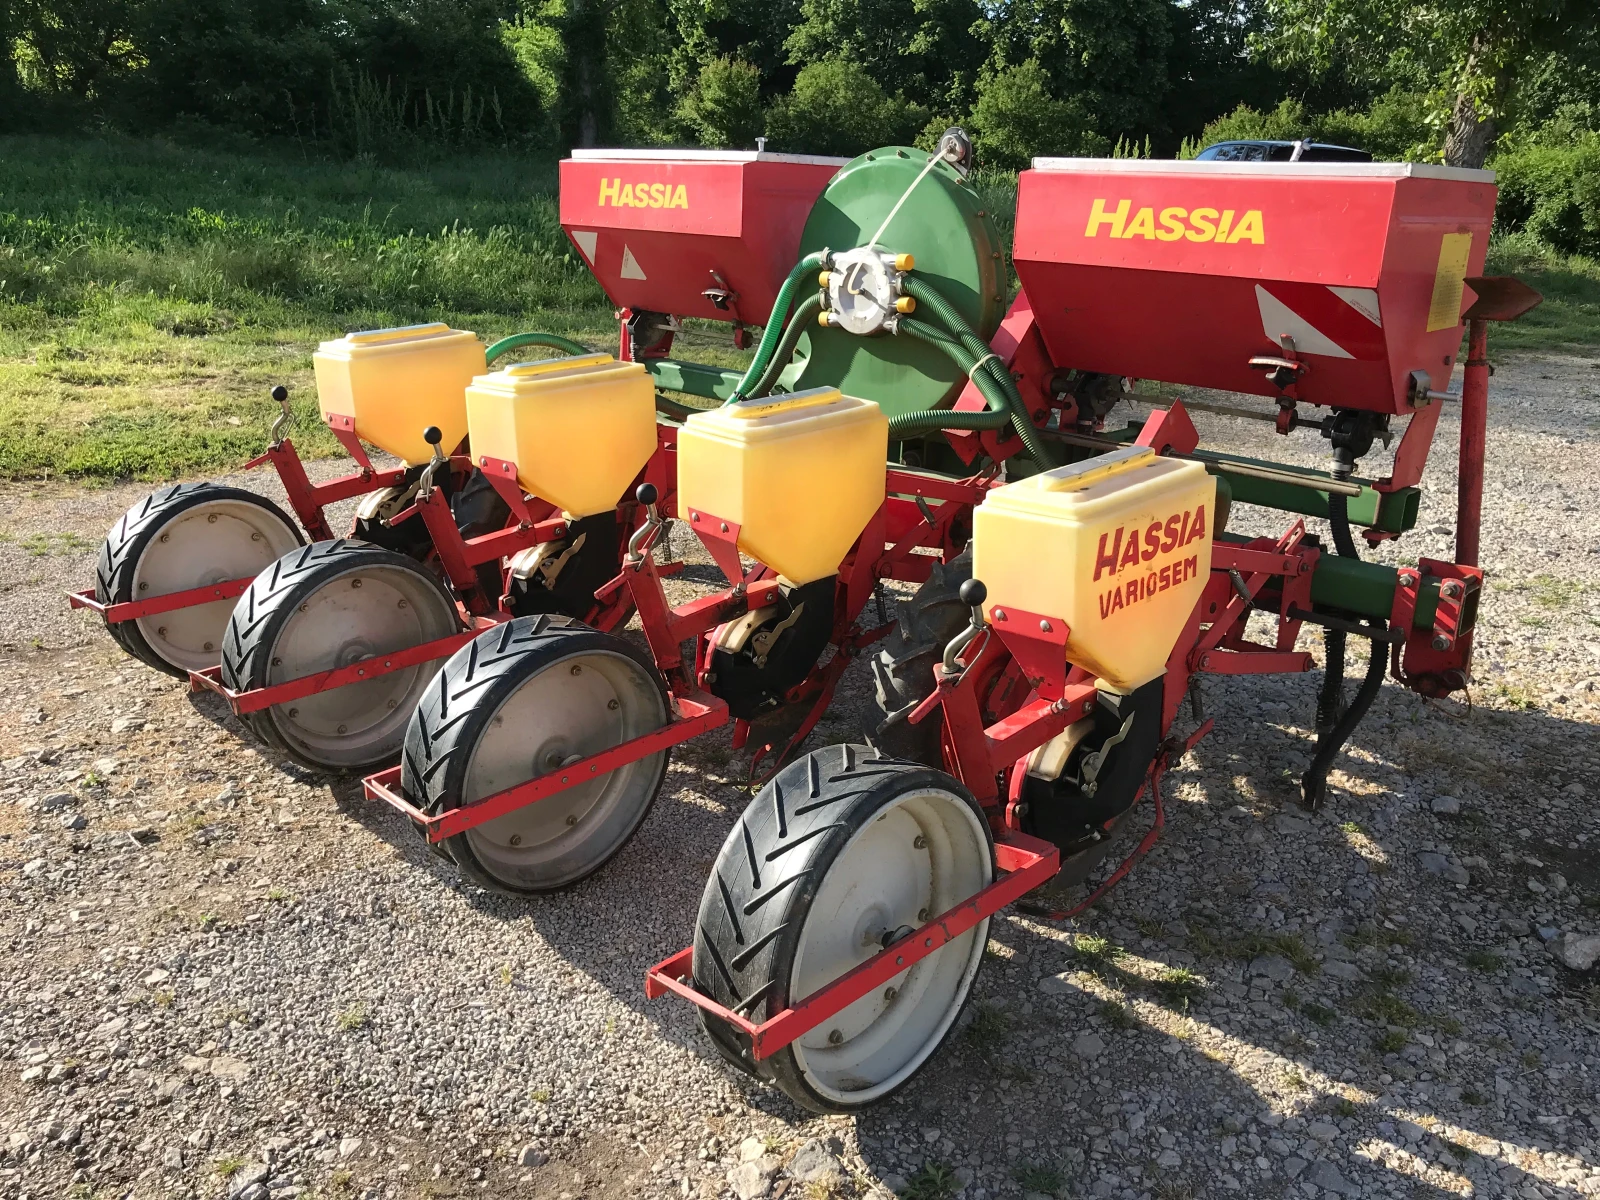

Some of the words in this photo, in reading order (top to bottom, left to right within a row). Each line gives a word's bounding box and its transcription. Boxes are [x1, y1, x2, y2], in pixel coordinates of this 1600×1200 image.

[598, 178, 688, 210] HASSIA
[1084, 198, 1266, 245] HASSIA
[1093, 505, 1205, 582] HASSIA
[1099, 554, 1198, 620] VARIOSEM
